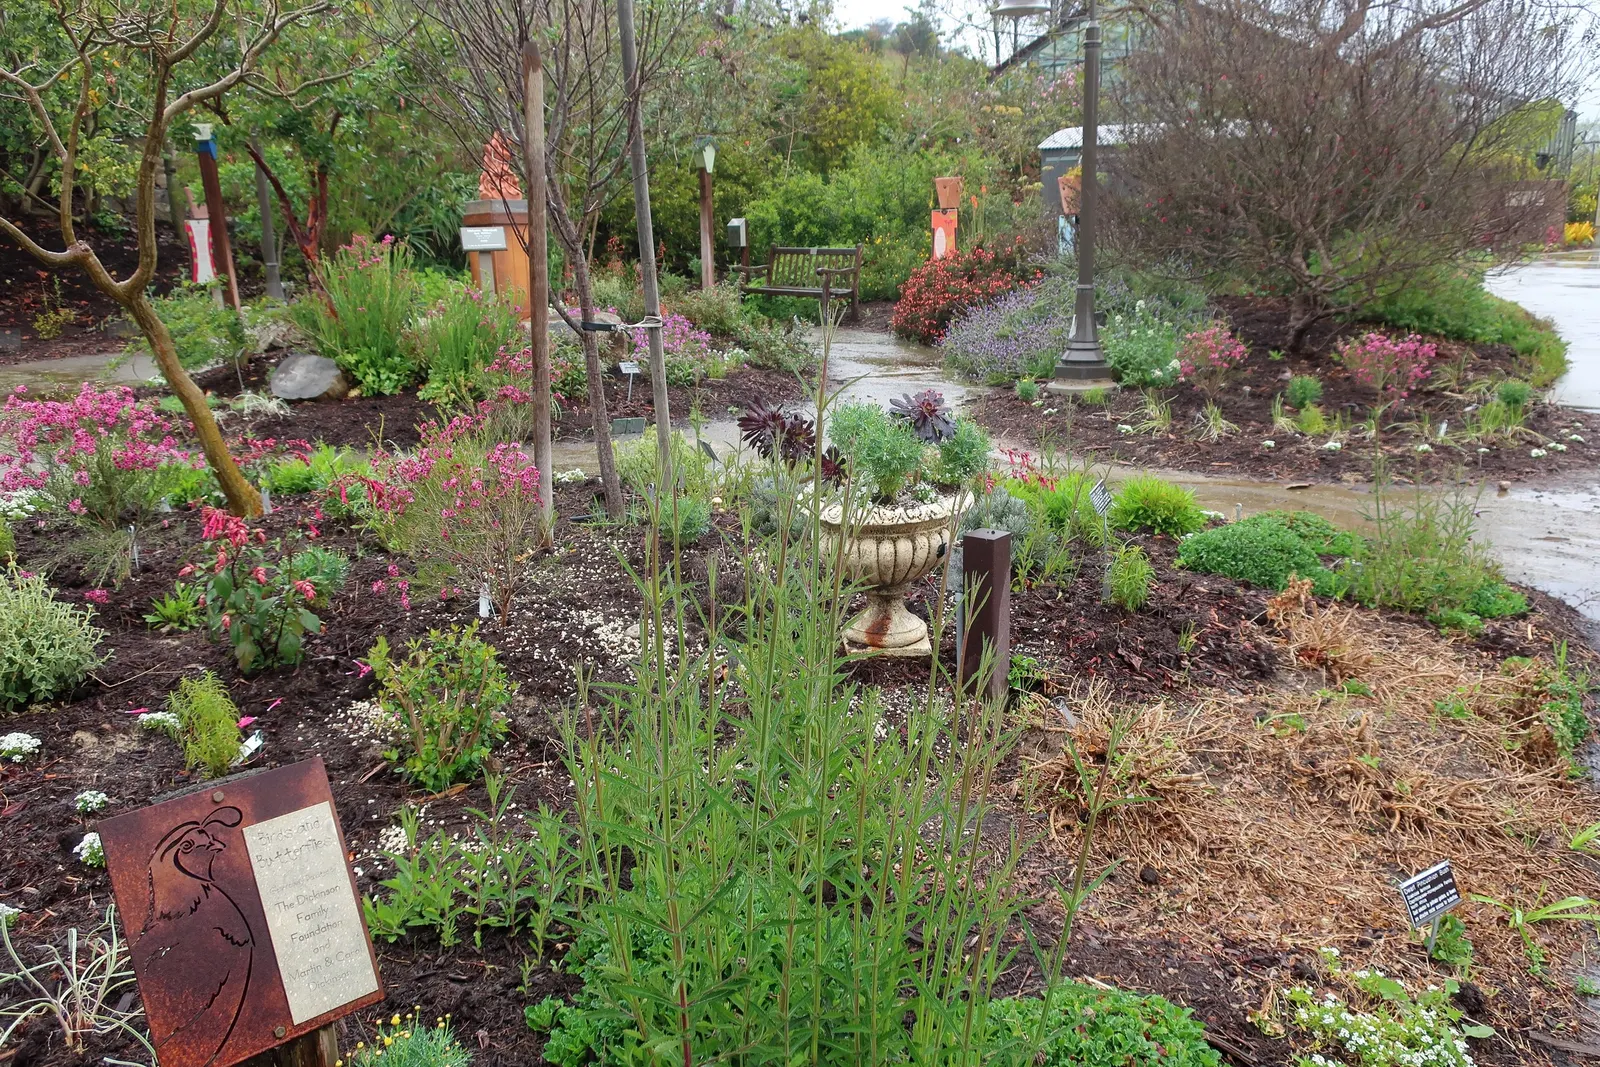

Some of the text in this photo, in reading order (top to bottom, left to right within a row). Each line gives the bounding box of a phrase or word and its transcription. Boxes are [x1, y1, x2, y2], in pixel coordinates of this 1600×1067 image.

[257, 818, 320, 846] Birds and
[256, 837, 332, 868] Butterflies
[275, 885, 341, 913] The Dickinson
[296, 905, 329, 923] Family
[290, 920, 343, 943] Foundation
[313, 938, 331, 954] and
[288, 964, 323, 981] Martin
[324, 957, 335, 967] &
[307, 970, 352, 992] Dickinson
